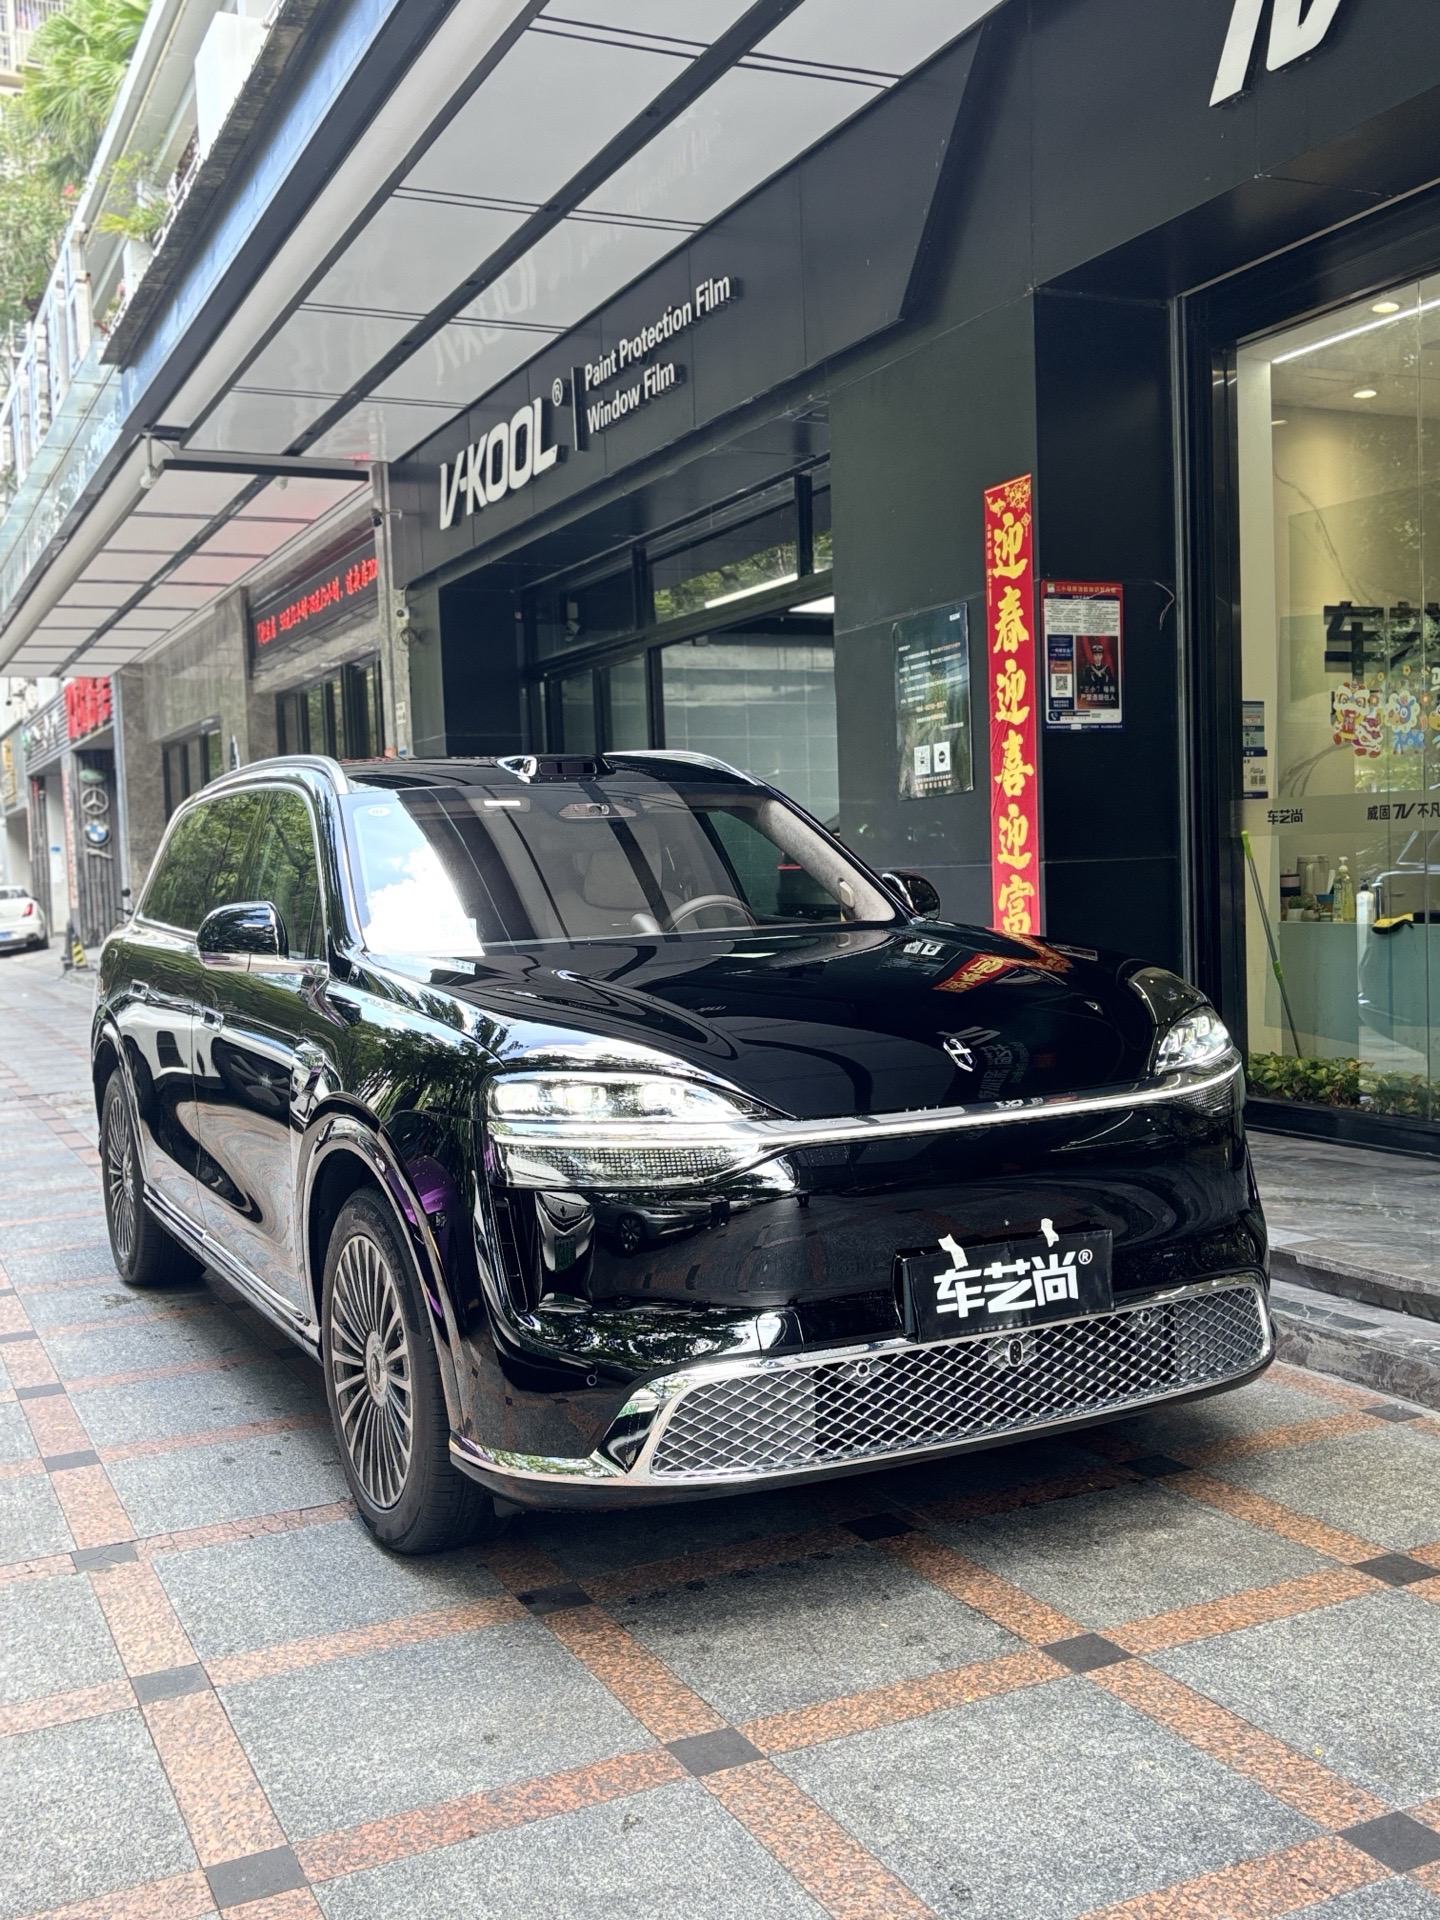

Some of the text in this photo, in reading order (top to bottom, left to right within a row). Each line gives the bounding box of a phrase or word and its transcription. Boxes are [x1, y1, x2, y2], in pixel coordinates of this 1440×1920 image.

[584, 274, 731, 391] Paint Protection Film
[586, 361, 676, 434] Window Film
[1266, 808, 1304, 825] 车艺尚
